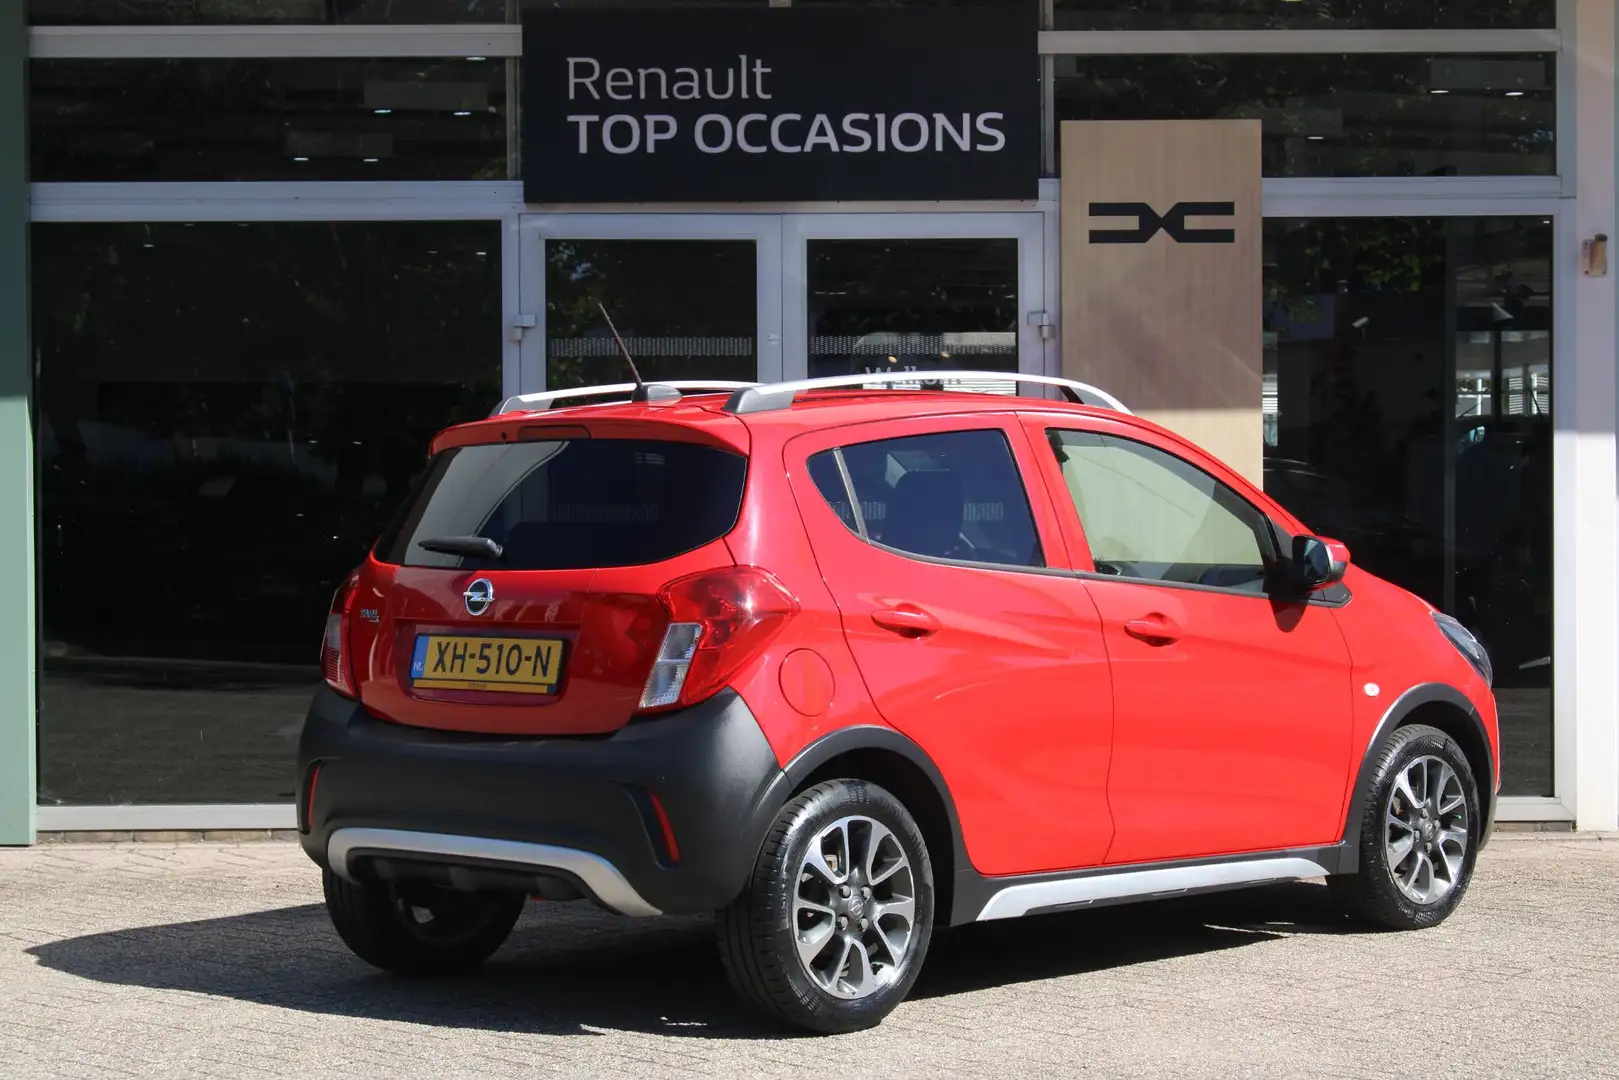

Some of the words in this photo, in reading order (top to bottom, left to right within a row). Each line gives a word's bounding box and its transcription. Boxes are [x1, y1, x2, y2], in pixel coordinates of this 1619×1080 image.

[567, 54, 772, 100] Renault
[567, 114, 678, 154] TOP
[694, 111, 1006, 154] OCCASIONS
[413, 661, 423, 671] NL
[432, 641, 552, 677] XH-510-N
